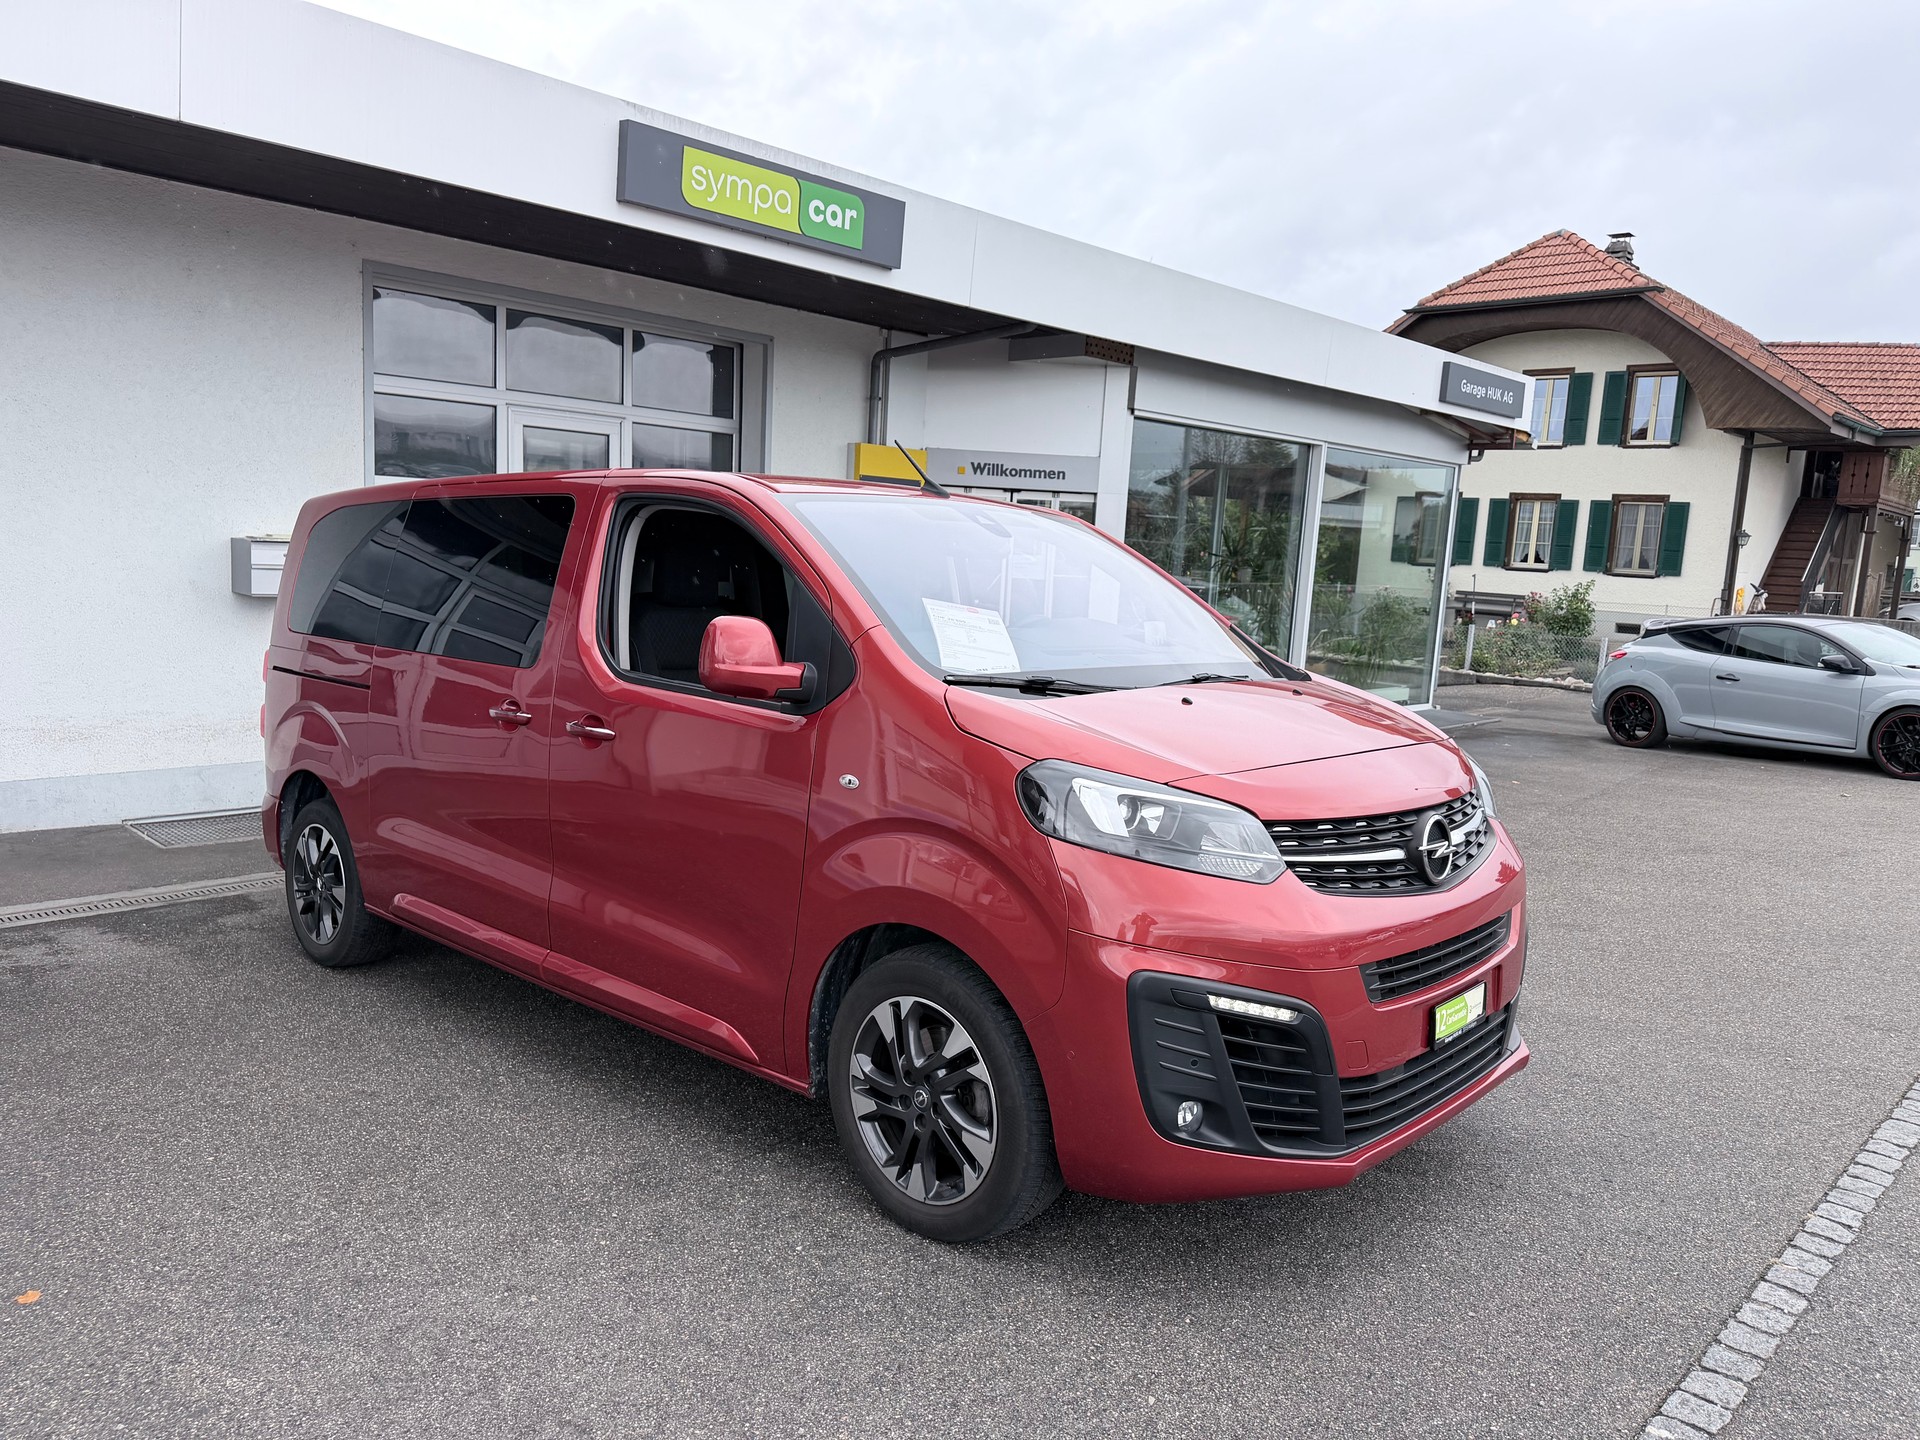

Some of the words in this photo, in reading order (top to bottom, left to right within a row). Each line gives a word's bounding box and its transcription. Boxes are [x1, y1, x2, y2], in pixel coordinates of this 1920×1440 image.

[691, 165, 792, 215] sympa
[808, 199, 857, 230] car
[1460, 379, 1486, 398] Garage
[1487, 386, 1502, 402] HUK
[1502, 390, 1514, 404] AG
[970, 461, 1066, 480] Willkommen
[1436, 1009, 1447, 1033] 12
